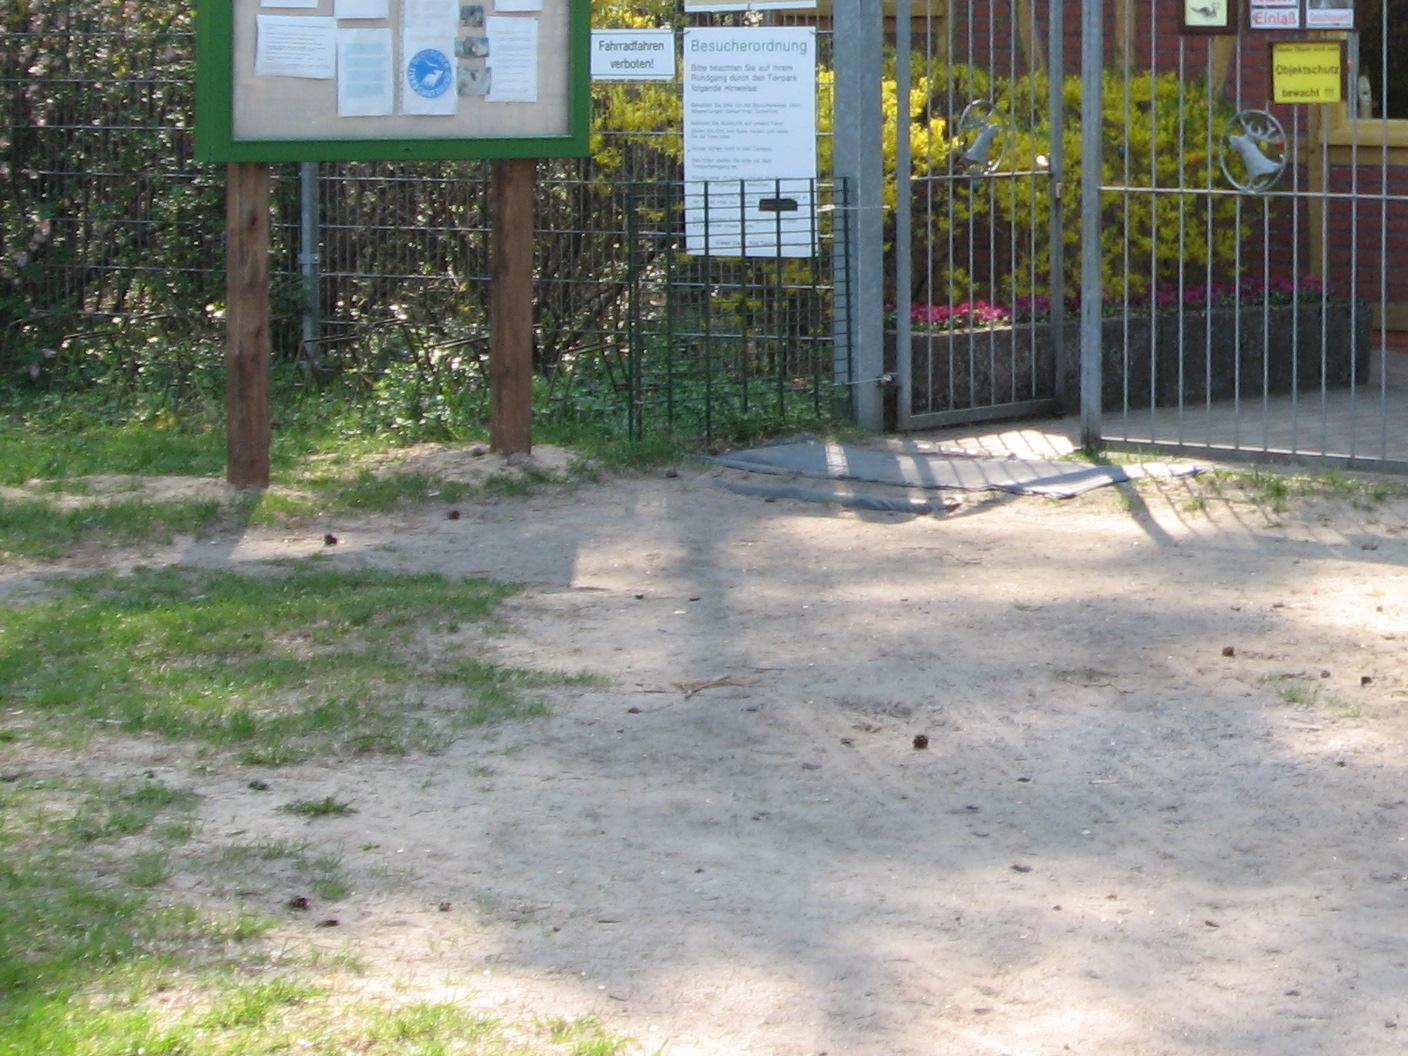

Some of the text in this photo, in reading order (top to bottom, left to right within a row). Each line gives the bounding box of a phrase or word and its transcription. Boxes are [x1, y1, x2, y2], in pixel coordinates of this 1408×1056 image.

[1255, 9, 1297, 24] Einlaß
[599, 40, 664, 51] Fahrradfahren
[691, 40, 808, 55] Besucherordnung
[610, 59, 655, 69] verboten!
[744, 64, 756, 72] Sie
[758, 63, 770, 72] auf
[1275, 64, 1339, 76] Objektschutz
[768, 74, 797, 83] Tierpark
[1282, 87, 1320, 97] bewacht
